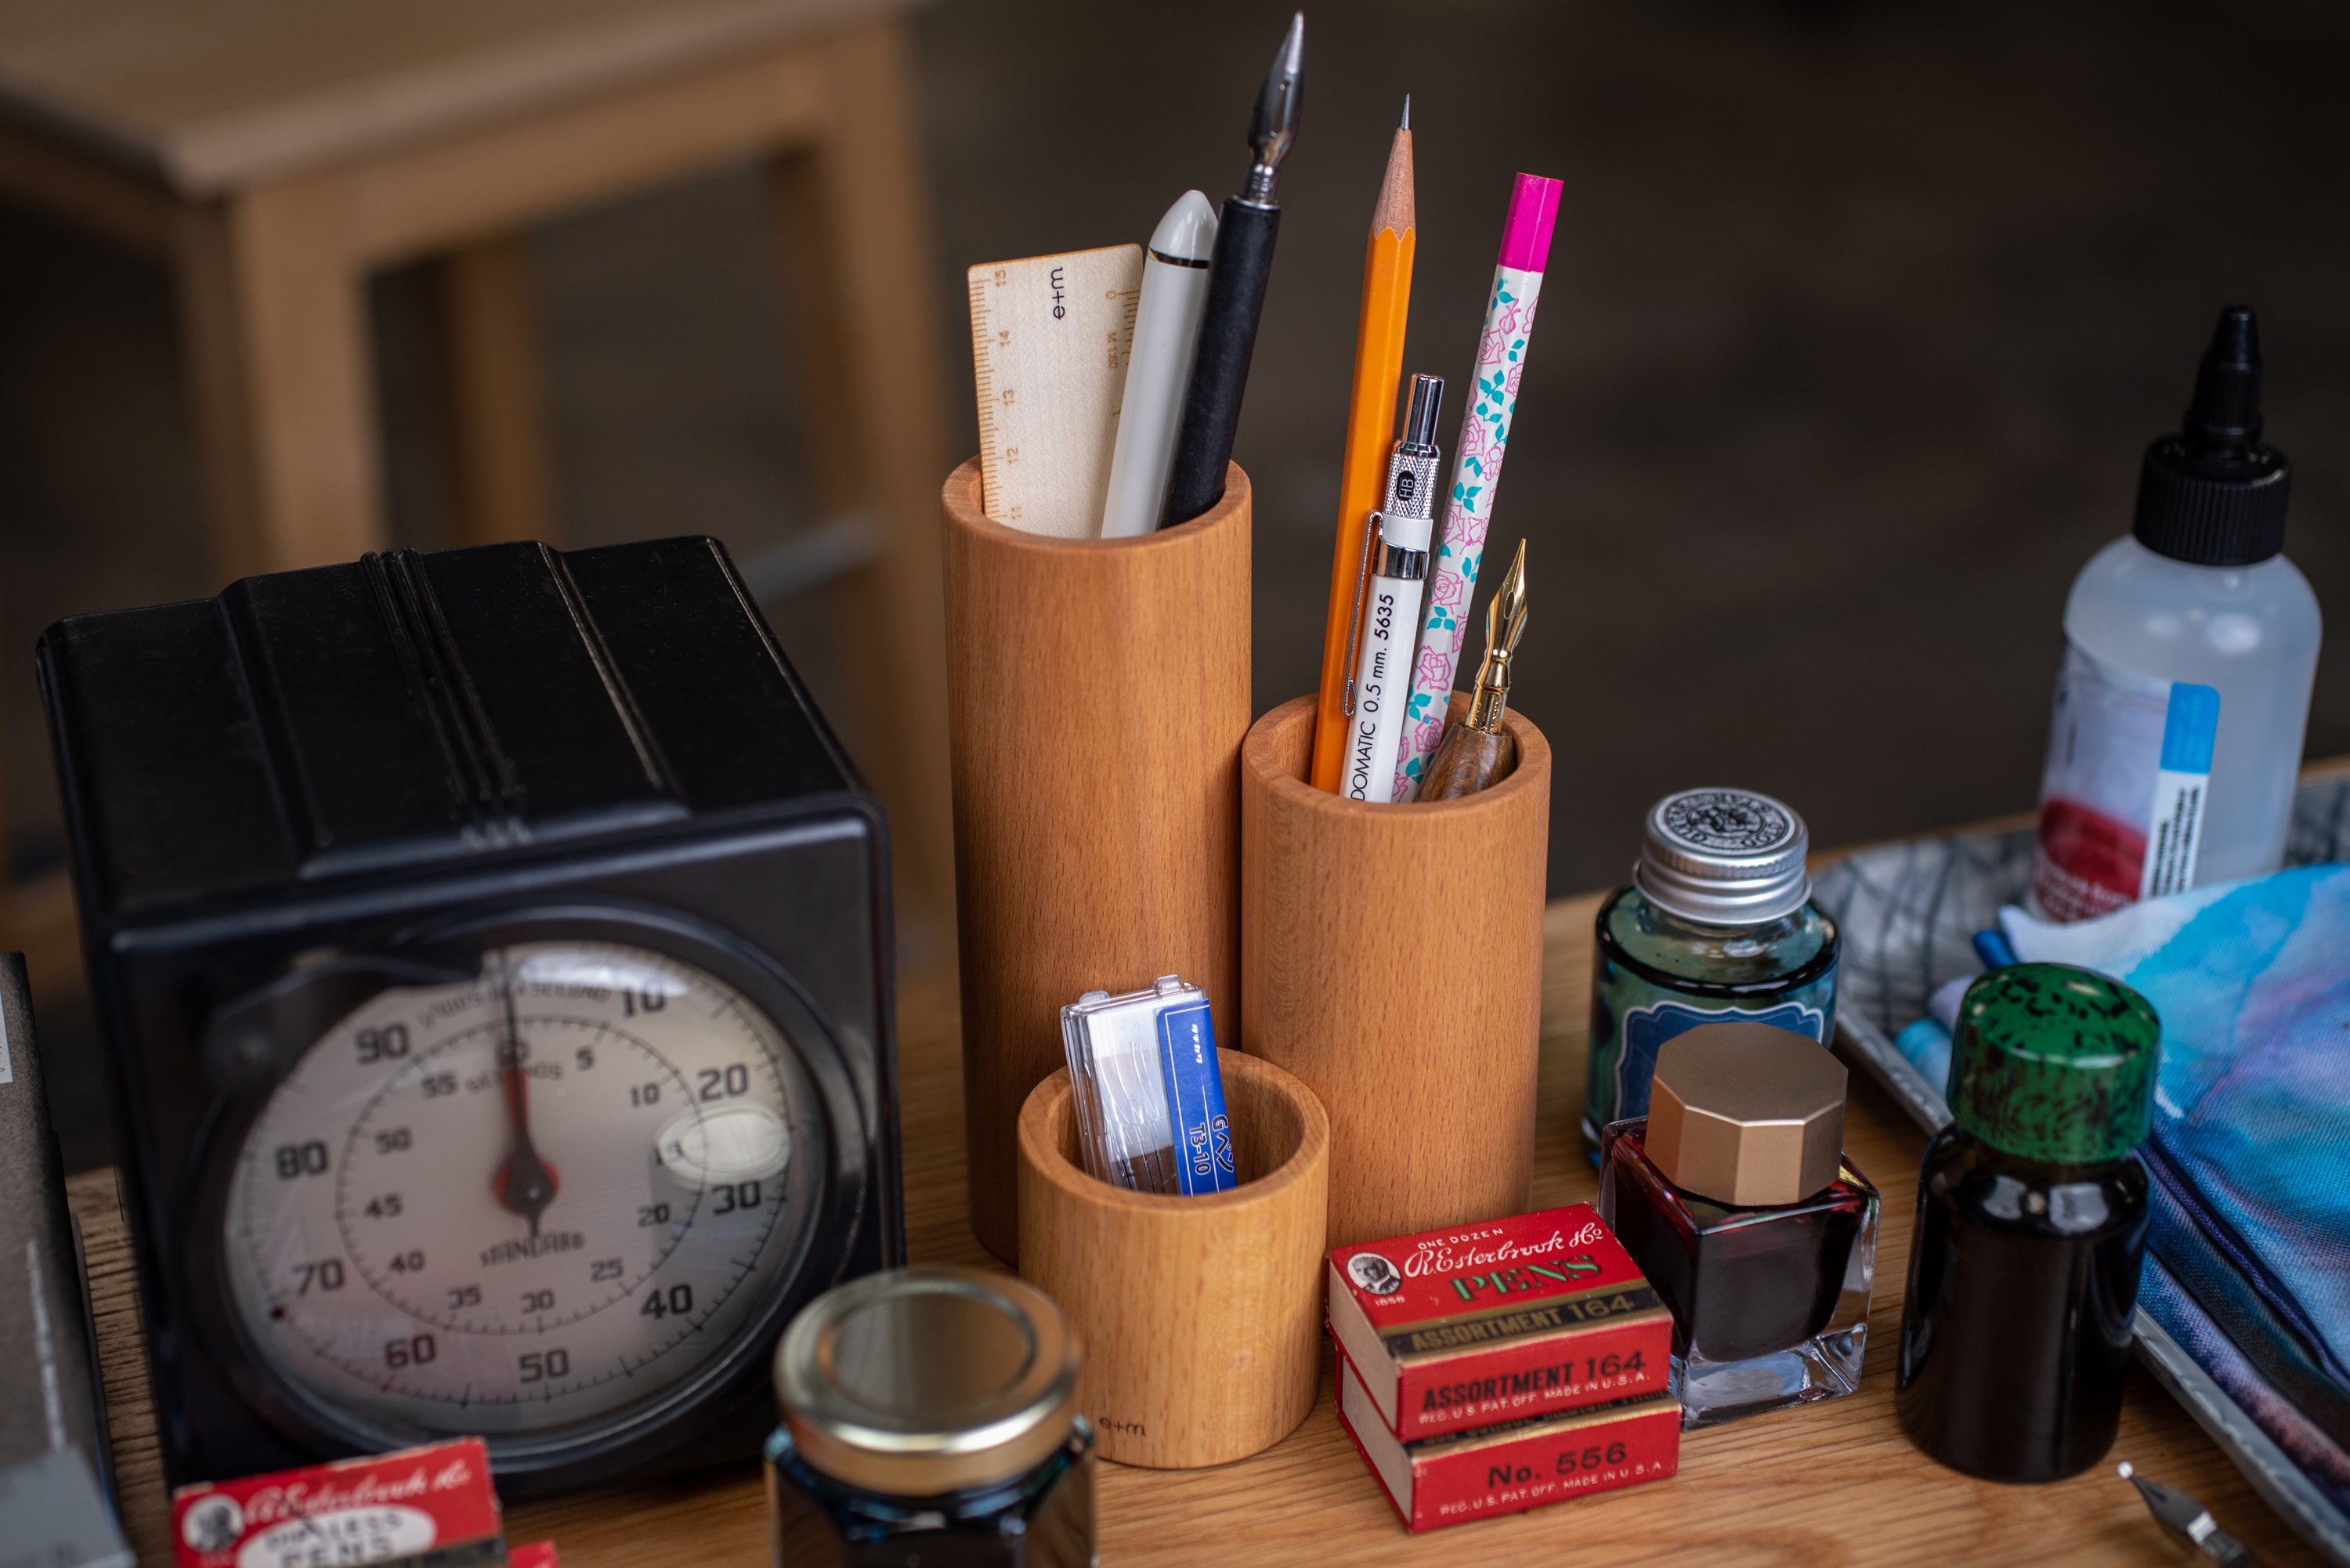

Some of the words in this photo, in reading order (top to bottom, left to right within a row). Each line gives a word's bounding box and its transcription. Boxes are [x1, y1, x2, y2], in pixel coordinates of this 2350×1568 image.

[995, 269, 1007, 287] 15
[1050, 266, 1065, 320] e+m
[1000, 330, 1010, 347] 14
[1003, 388, 1015, 406] 13
[1007, 447, 1018, 464] 12
[1399, 479, 1414, 497] HB
[1010, 506, 1022, 520] 11
[1374, 594, 1394, 641] 5635
[1372, 648, 1387, 679] mm.
[1363, 683, 1381, 713] 0.5
[624, 980, 666, 1017] 10
[356, 1024, 409, 1064] 90
[576, 1046, 594, 1071] 5
[421, 1073, 457, 1097] 55
[630, 1083, 660, 1107] 10
[698, 1064, 748, 1104] 20
[375, 1127, 412, 1154] 50
[1189, 1122, 1211, 1175] T3-10
[1213, 1115, 1234, 1173] Gペン
[275, 1140, 328, 1180] 80
[364, 1194, 403, 1219] 45
[713, 1181, 761, 1215] 30
[638, 1204, 670, 1227] 20
[1418, 1239, 1445, 1250] ONE
[1450, 1228, 1504, 1244] DOZEN
[389, 1249, 425, 1274] 40
[590, 1258, 623, 1283] 25
[291, 1258, 345, 1296] 70
[1452, 1255, 1603, 1302] PENS
[446, 1285, 483, 1310] 35
[520, 1289, 555, 1314] 30
[640, 1284, 693, 1320] 40
[1411, 1306, 1564, 1352] ASSORTMENT
[1568, 1294, 1635, 1321] 164
[385, 1334, 436, 1368] 60
[519, 1348, 569, 1384] 50
[1423, 1361, 1575, 1411] ASSORTMENT
[1585, 1350, 1646, 1381] 164
[1545, 1386, 1581, 1400] MADE
[1585, 1381, 1598, 1391] IN
[1099, 1417, 1146, 1436] e+m
[1489, 1463, 1542, 1489] No.
[1556, 1442, 1627, 1475] 556
[1564, 1475, 1599, 1490] MADE
[1603, 1472, 1616, 1482] IN
